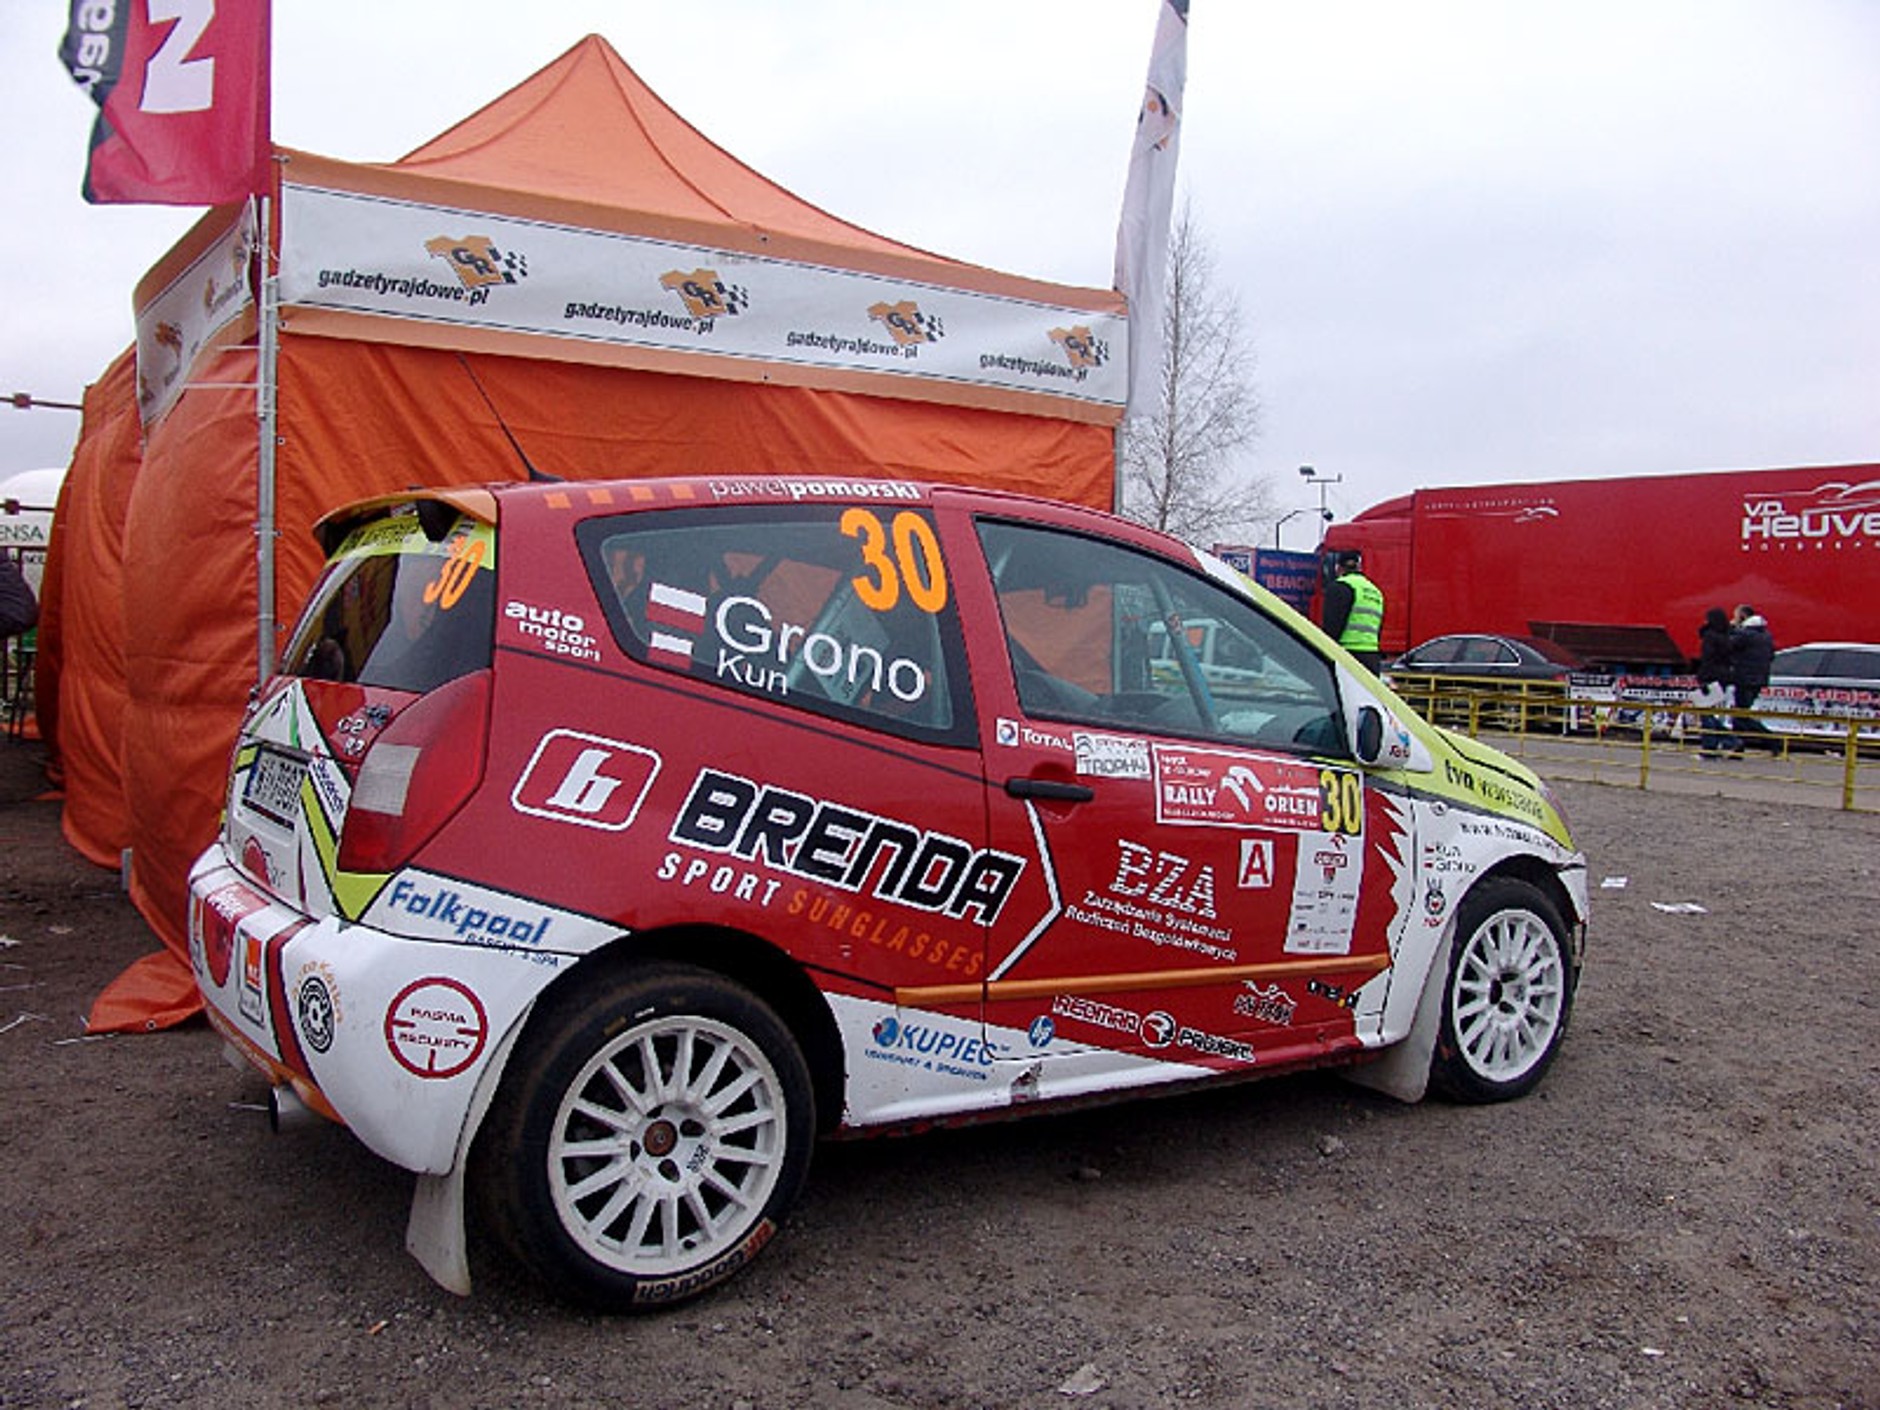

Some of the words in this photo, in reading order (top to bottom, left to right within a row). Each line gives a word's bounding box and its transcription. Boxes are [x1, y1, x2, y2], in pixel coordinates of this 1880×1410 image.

[318, 268, 490, 306] gadzetyrajdowe.pl
[564, 301, 714, 335] gadzetyrajdowe.pl
[423, 535, 487, 611] 30
[841, 507, 948, 613] 30
[505, 602, 585, 632] auto
[519, 619, 597, 648] motor
[544, 639, 601, 662] sport
[715, 597, 926, 702] Grono
[716, 649, 788, 696] Kun
[1164, 785, 1217, 806] RALLY
[1264, 794, 1318, 817] ORLEN
[1320, 769, 1361, 834] 30
[668, 767, 1028, 927] BRENDA
[1240, 842, 1270, 885] A
[1109, 838, 1217, 920] BZA
[657, 852, 782, 908] SPORT
[787, 889, 985, 976] SUNGLASSES
[899, 1024, 998, 1067] KUPIEC
